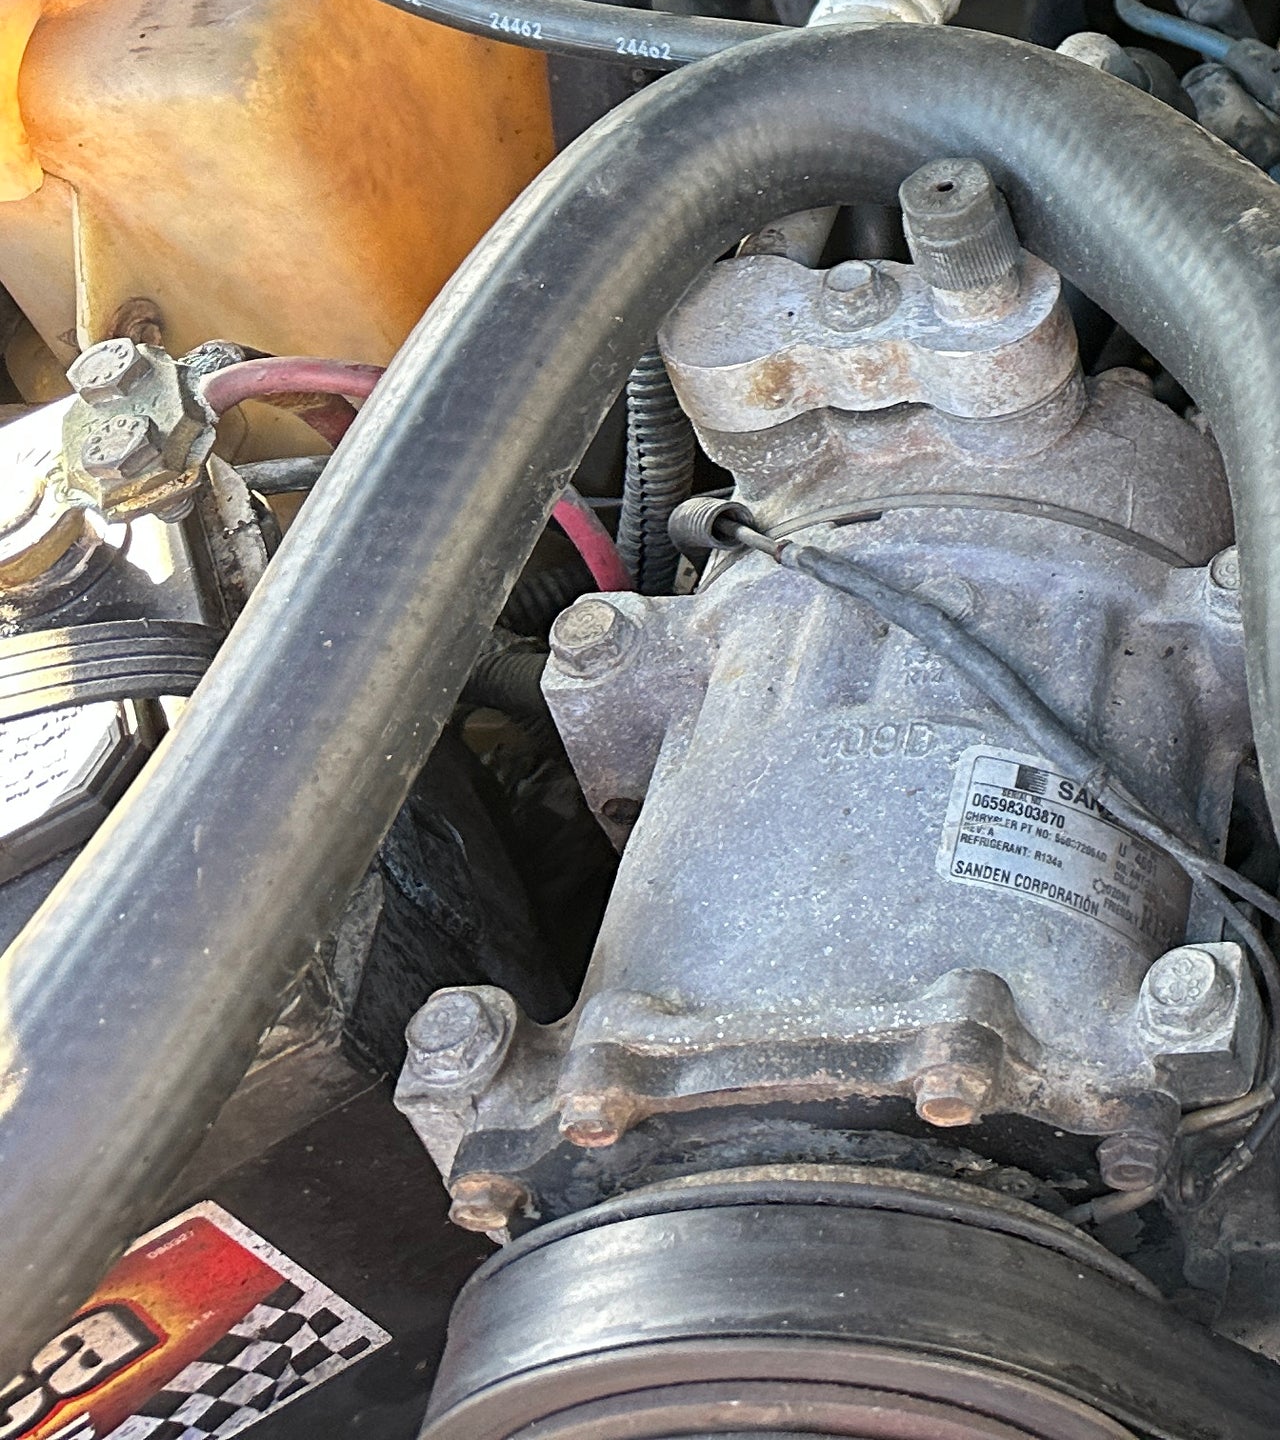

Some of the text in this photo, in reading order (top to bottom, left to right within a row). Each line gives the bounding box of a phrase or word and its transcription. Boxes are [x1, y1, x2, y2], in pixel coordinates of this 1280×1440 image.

[488, 12, 543, 41] 24462
[971, 792, 1066, 830] 06598303870
[1020, 822, 1033, 835] PT
[960, 832, 1032, 860] REFRIGERANT:
[954, 860, 1011, 885] SANDEN
[1013, 872, 1100, 918] CORPORATION
